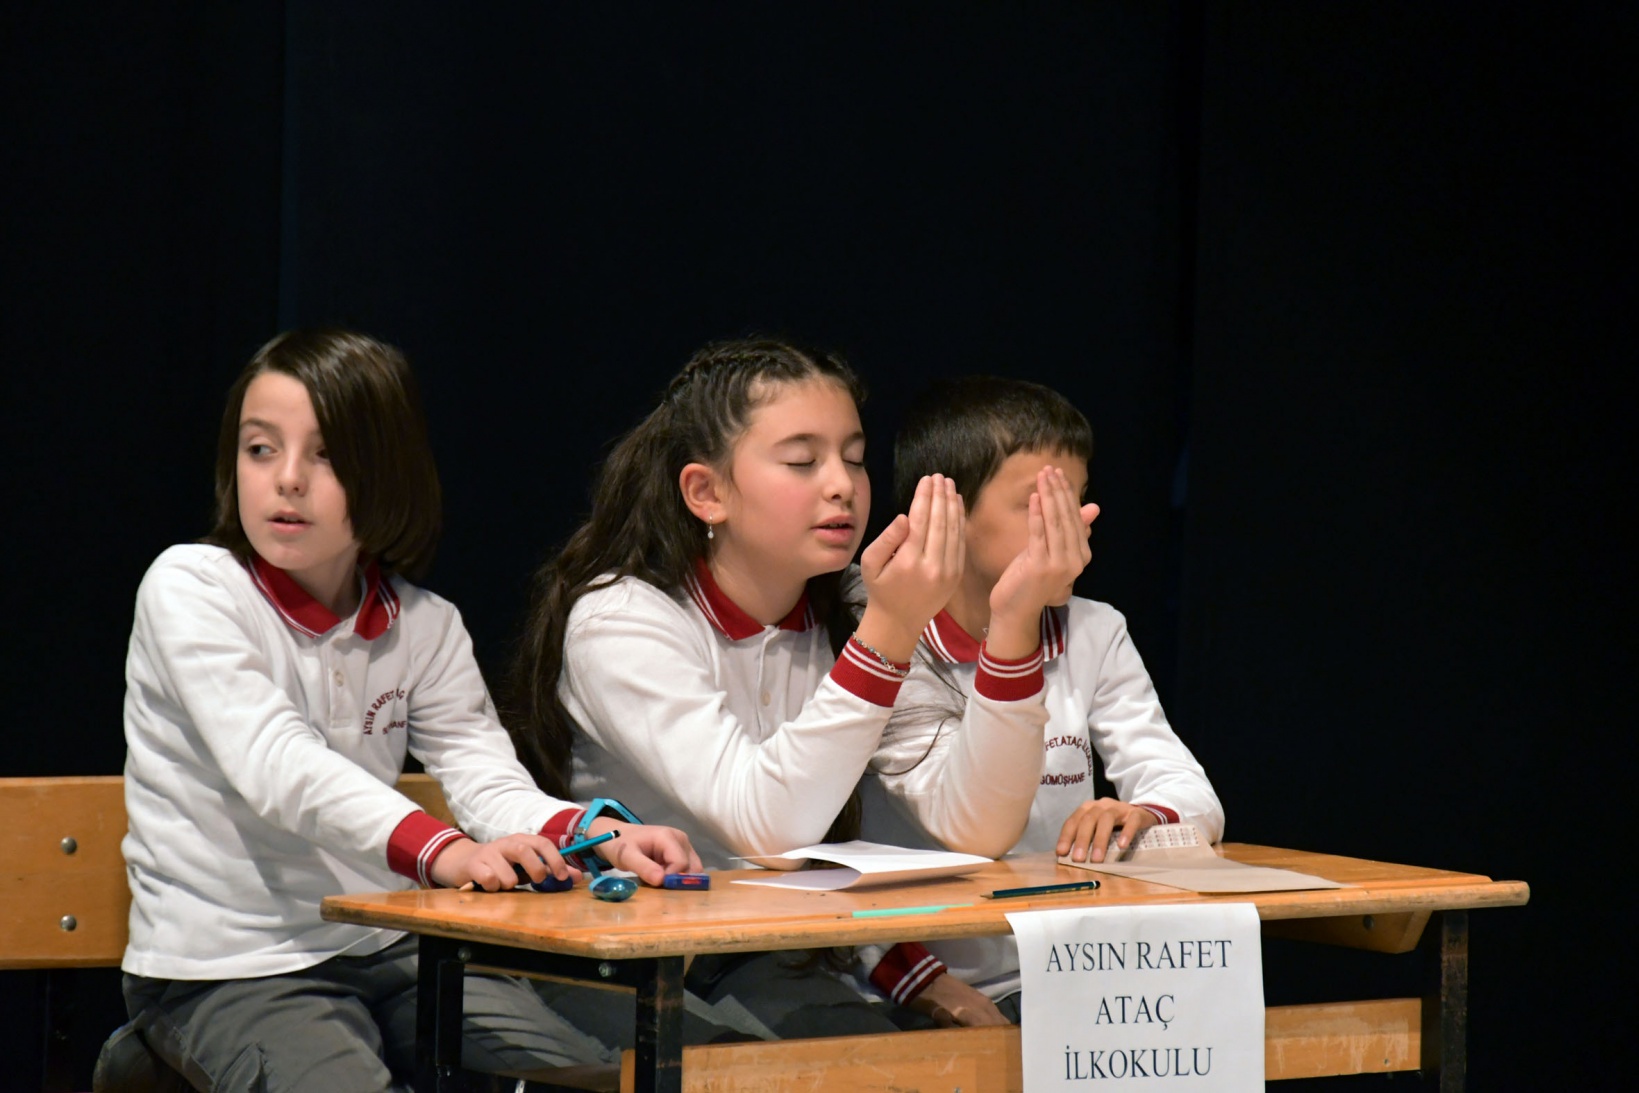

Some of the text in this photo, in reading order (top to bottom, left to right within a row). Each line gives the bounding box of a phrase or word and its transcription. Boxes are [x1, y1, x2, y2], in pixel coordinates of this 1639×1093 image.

[363, 710, 376, 735] AYSIN
[371, 689, 395, 711] RAFET
[1046, 940, 1232, 972] AYSIN RAFET
[1095, 994, 1175, 1031] ATAÇ
[1064, 1045, 1213, 1081] İLKOKULU
